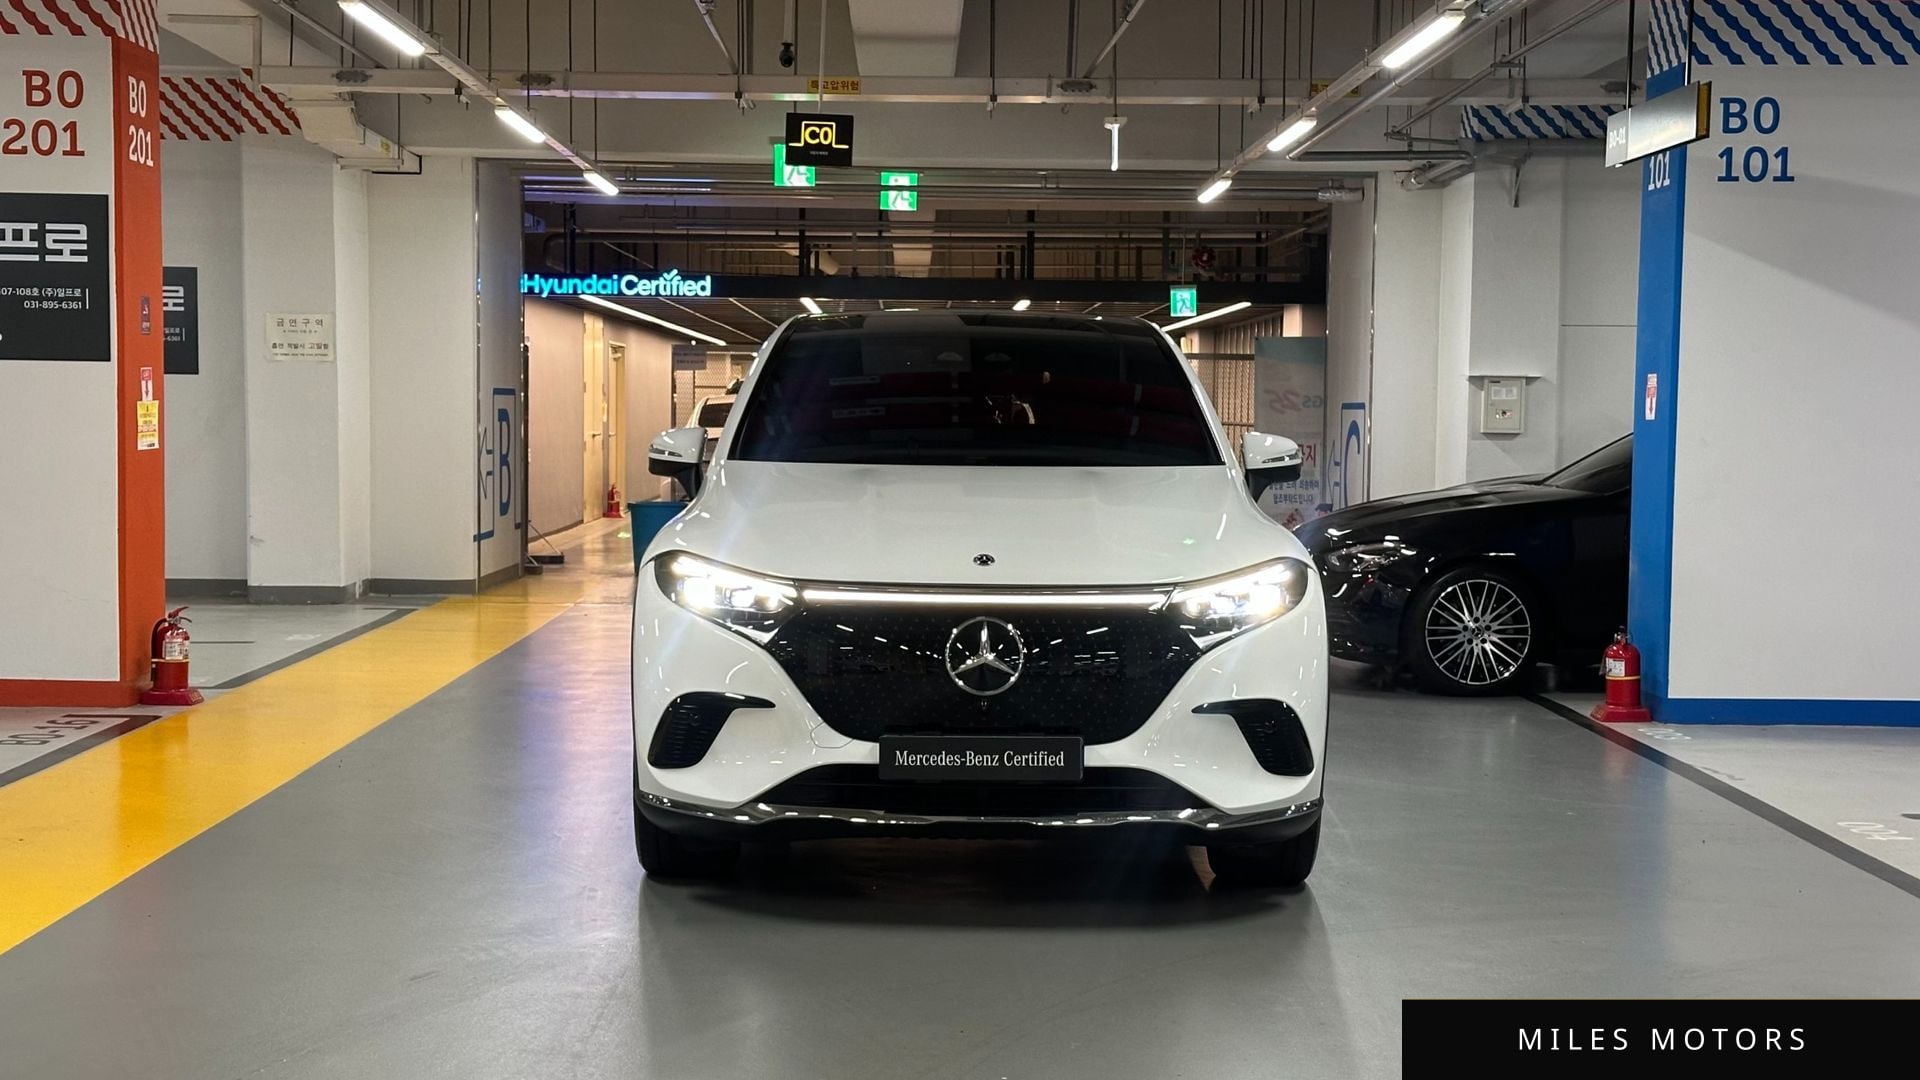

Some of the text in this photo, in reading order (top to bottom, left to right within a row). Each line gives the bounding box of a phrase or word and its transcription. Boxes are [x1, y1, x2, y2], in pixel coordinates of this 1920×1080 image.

[22, 69, 84, 109] B0
[127, 75, 147, 118] B0
[1719, 96, 1780, 135] B0
[2, 118, 85, 157] 201
[128, 124, 154, 167] 201
[1647, 150, 1670, 191] 101
[1717, 146, 1795, 183] 101
[0, 287, 82, 297] 07-108호 (주)일프로
[522, 269, 711, 298] Hyundai Certified
[23, 300, 82, 309] 031-895-6361
[895, 750, 1065, 767] Mercedes-Benz Certified
